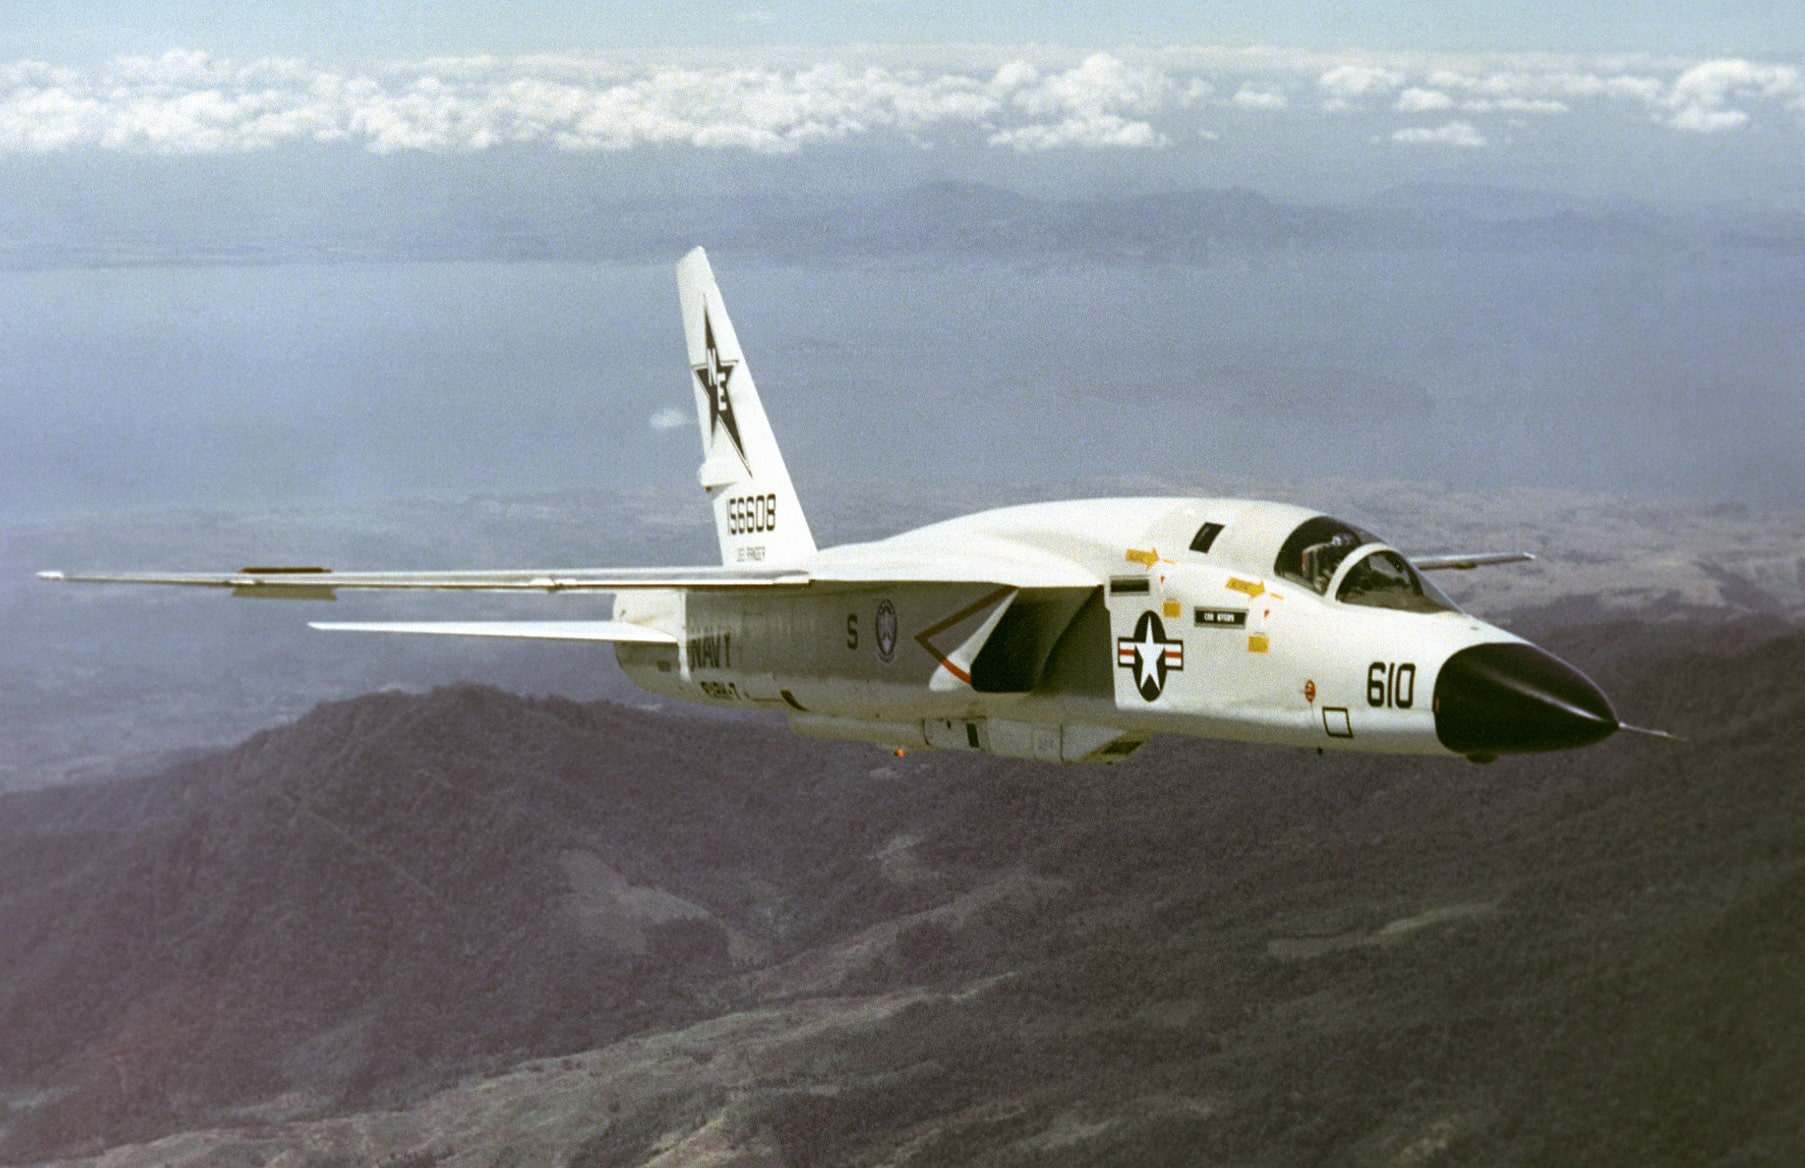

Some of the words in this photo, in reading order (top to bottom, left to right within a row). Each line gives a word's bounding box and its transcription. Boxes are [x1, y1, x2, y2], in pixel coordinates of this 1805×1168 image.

[727, 493, 777, 535] 156608
[846, 613, 859, 650] S
[1366, 661, 1417, 709] 610
